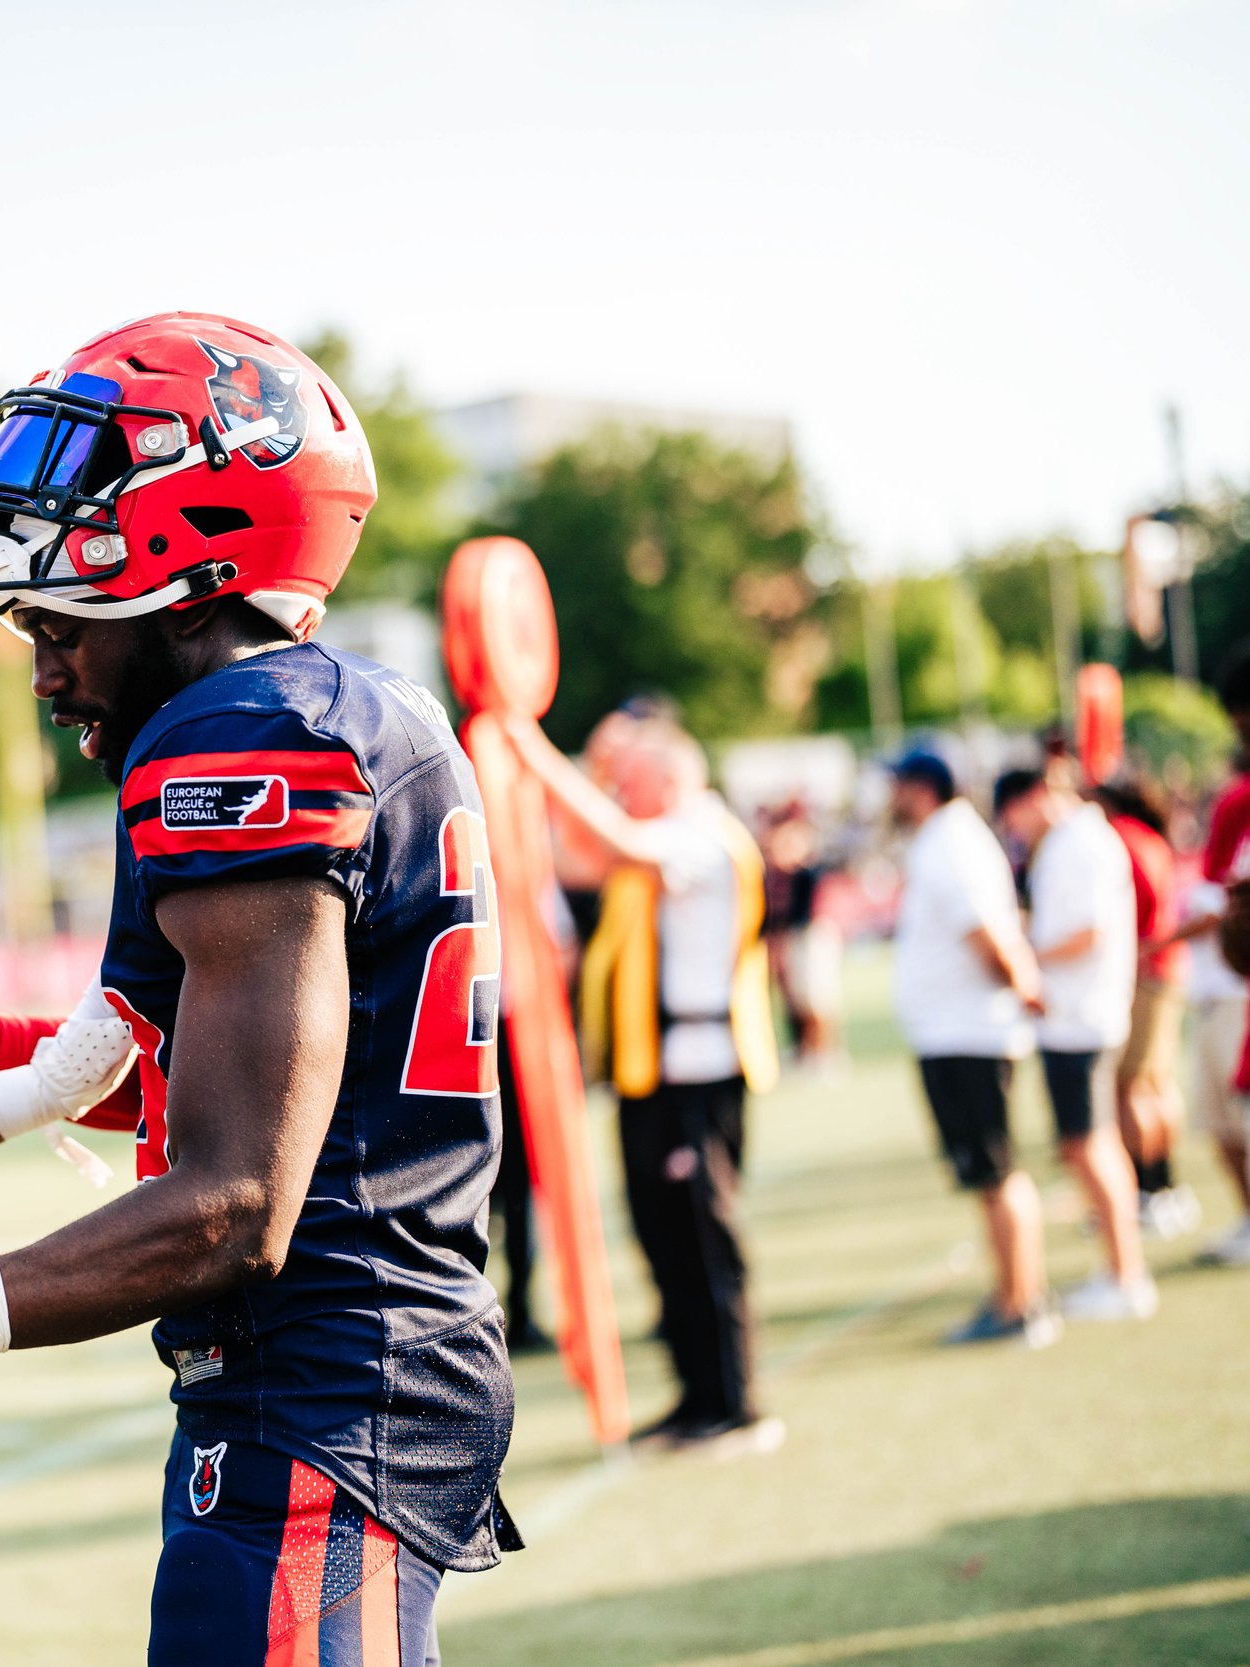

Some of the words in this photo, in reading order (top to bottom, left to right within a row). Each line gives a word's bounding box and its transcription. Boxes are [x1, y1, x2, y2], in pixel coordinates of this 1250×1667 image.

[166, 786, 222, 798] EUROPEAN
[166, 799, 204, 810] LEAGUE
[166, 809, 219, 821] FOOTBALL
